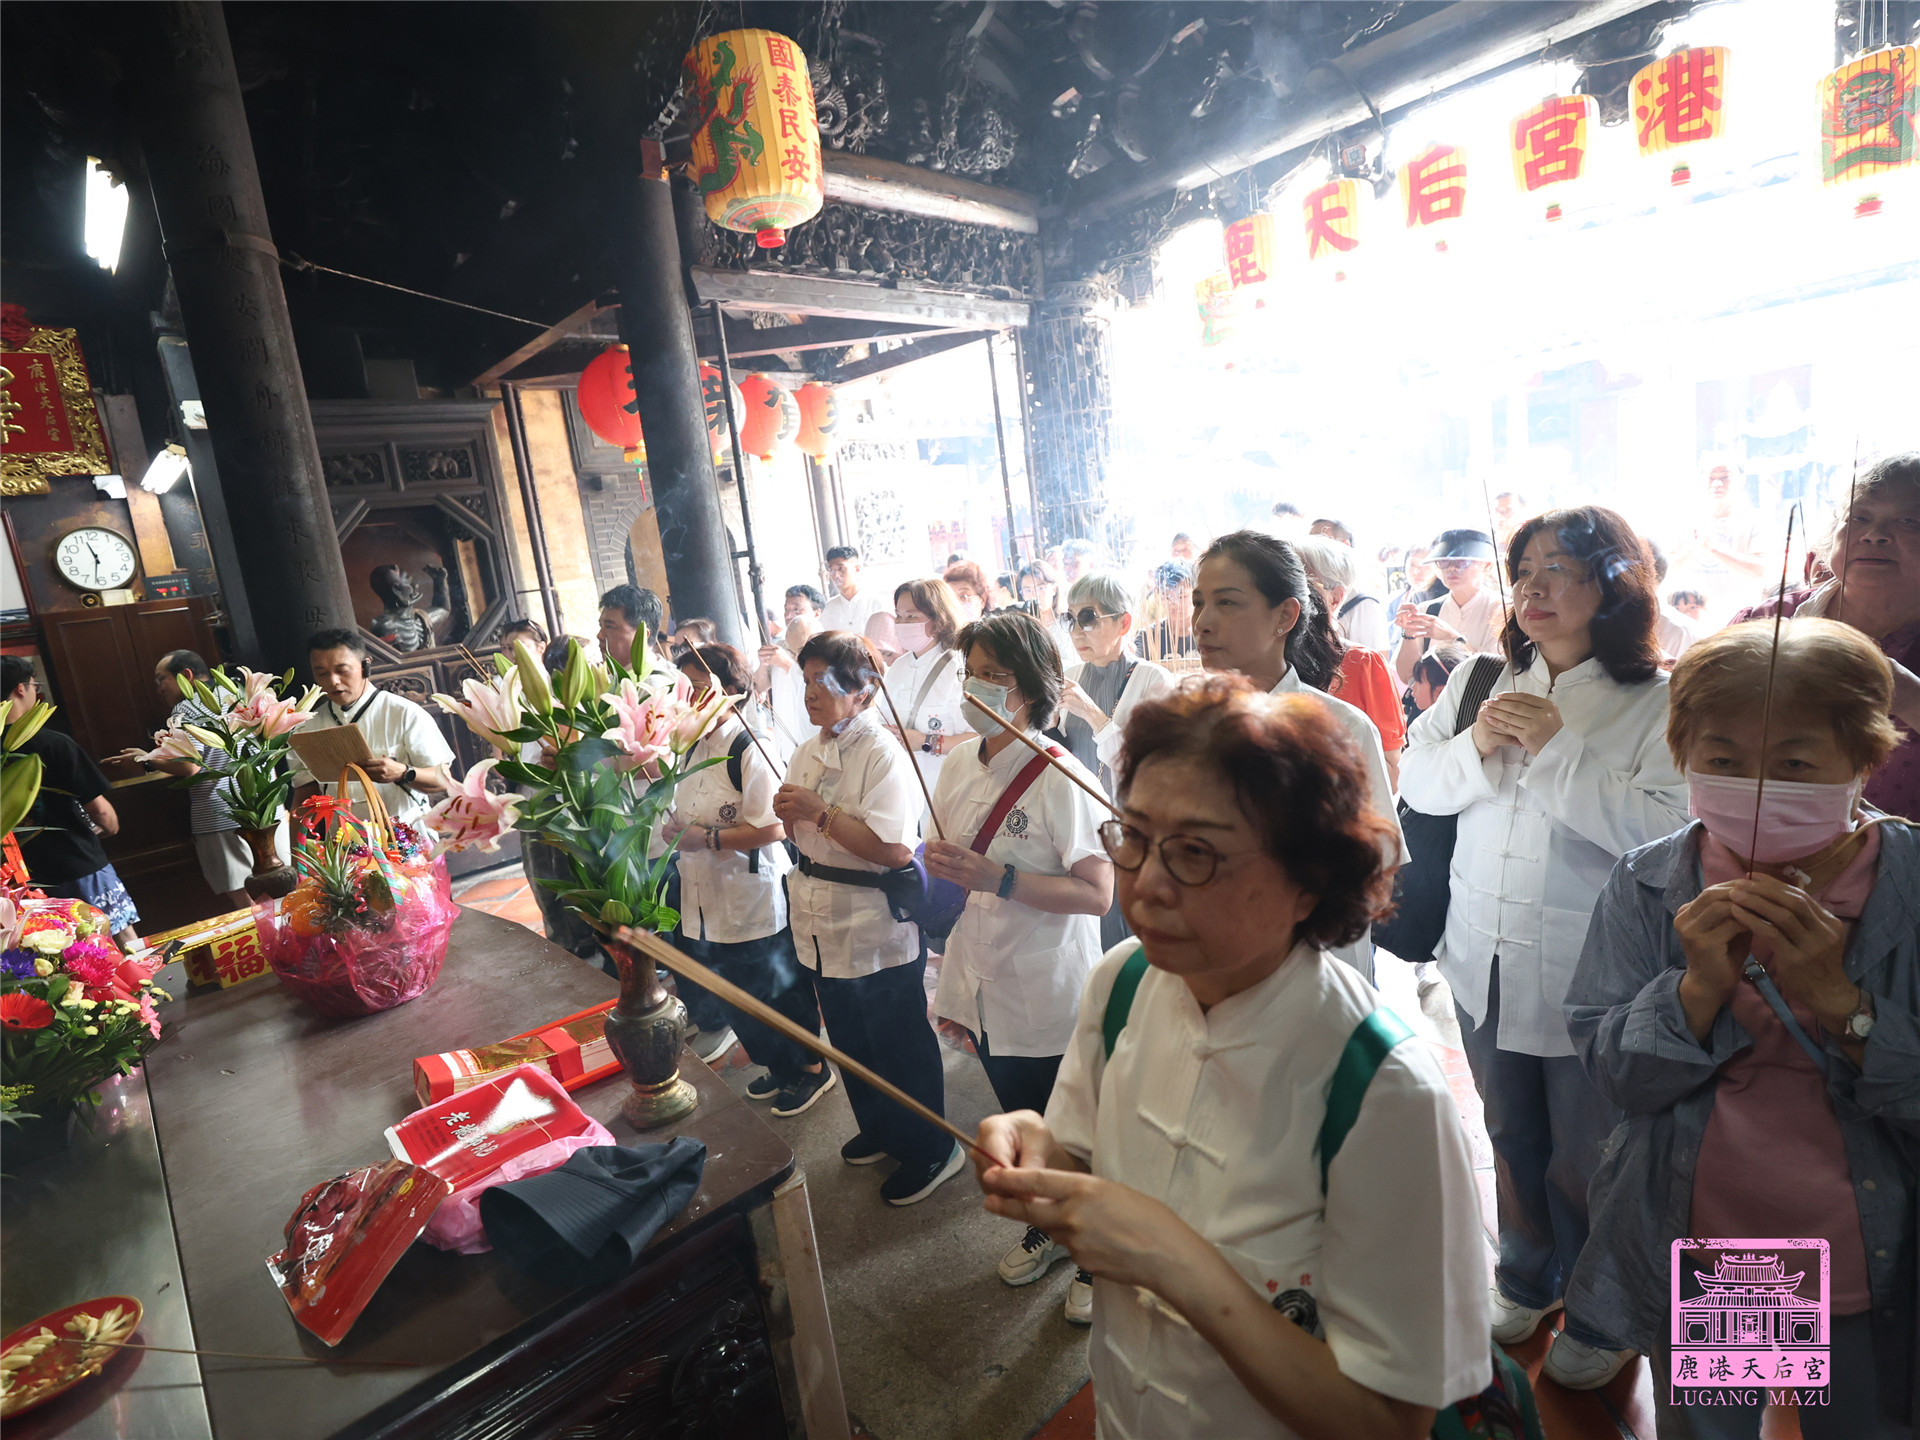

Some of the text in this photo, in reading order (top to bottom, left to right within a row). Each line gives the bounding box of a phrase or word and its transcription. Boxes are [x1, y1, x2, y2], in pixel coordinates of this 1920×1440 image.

[1636, 47, 1722, 146] 港
[766, 37, 811, 183] 國泰民安
[1514, 95, 1591, 191] 宮
[1405, 145, 1467, 228] 后
[1303, 182, 1359, 260] 天
[26, 358, 61, 442] 鹿港天后宮
[73, 536, 84, 544] 11
[85, 531, 99, 541] 12
[105, 534, 110, 543] 1
[64, 544, 79, 554] 10
[114, 542, 124, 552] 2
[62, 556, 73, 565] 9
[120, 552, 130, 562] 3
[69, 566, 80, 576] 8
[120, 563, 128, 572] 4
[81, 574, 90, 583] 7
[96, 576, 107, 586] 6
[111, 572, 120, 581] 5
[214, 935, 265, 983] 福
